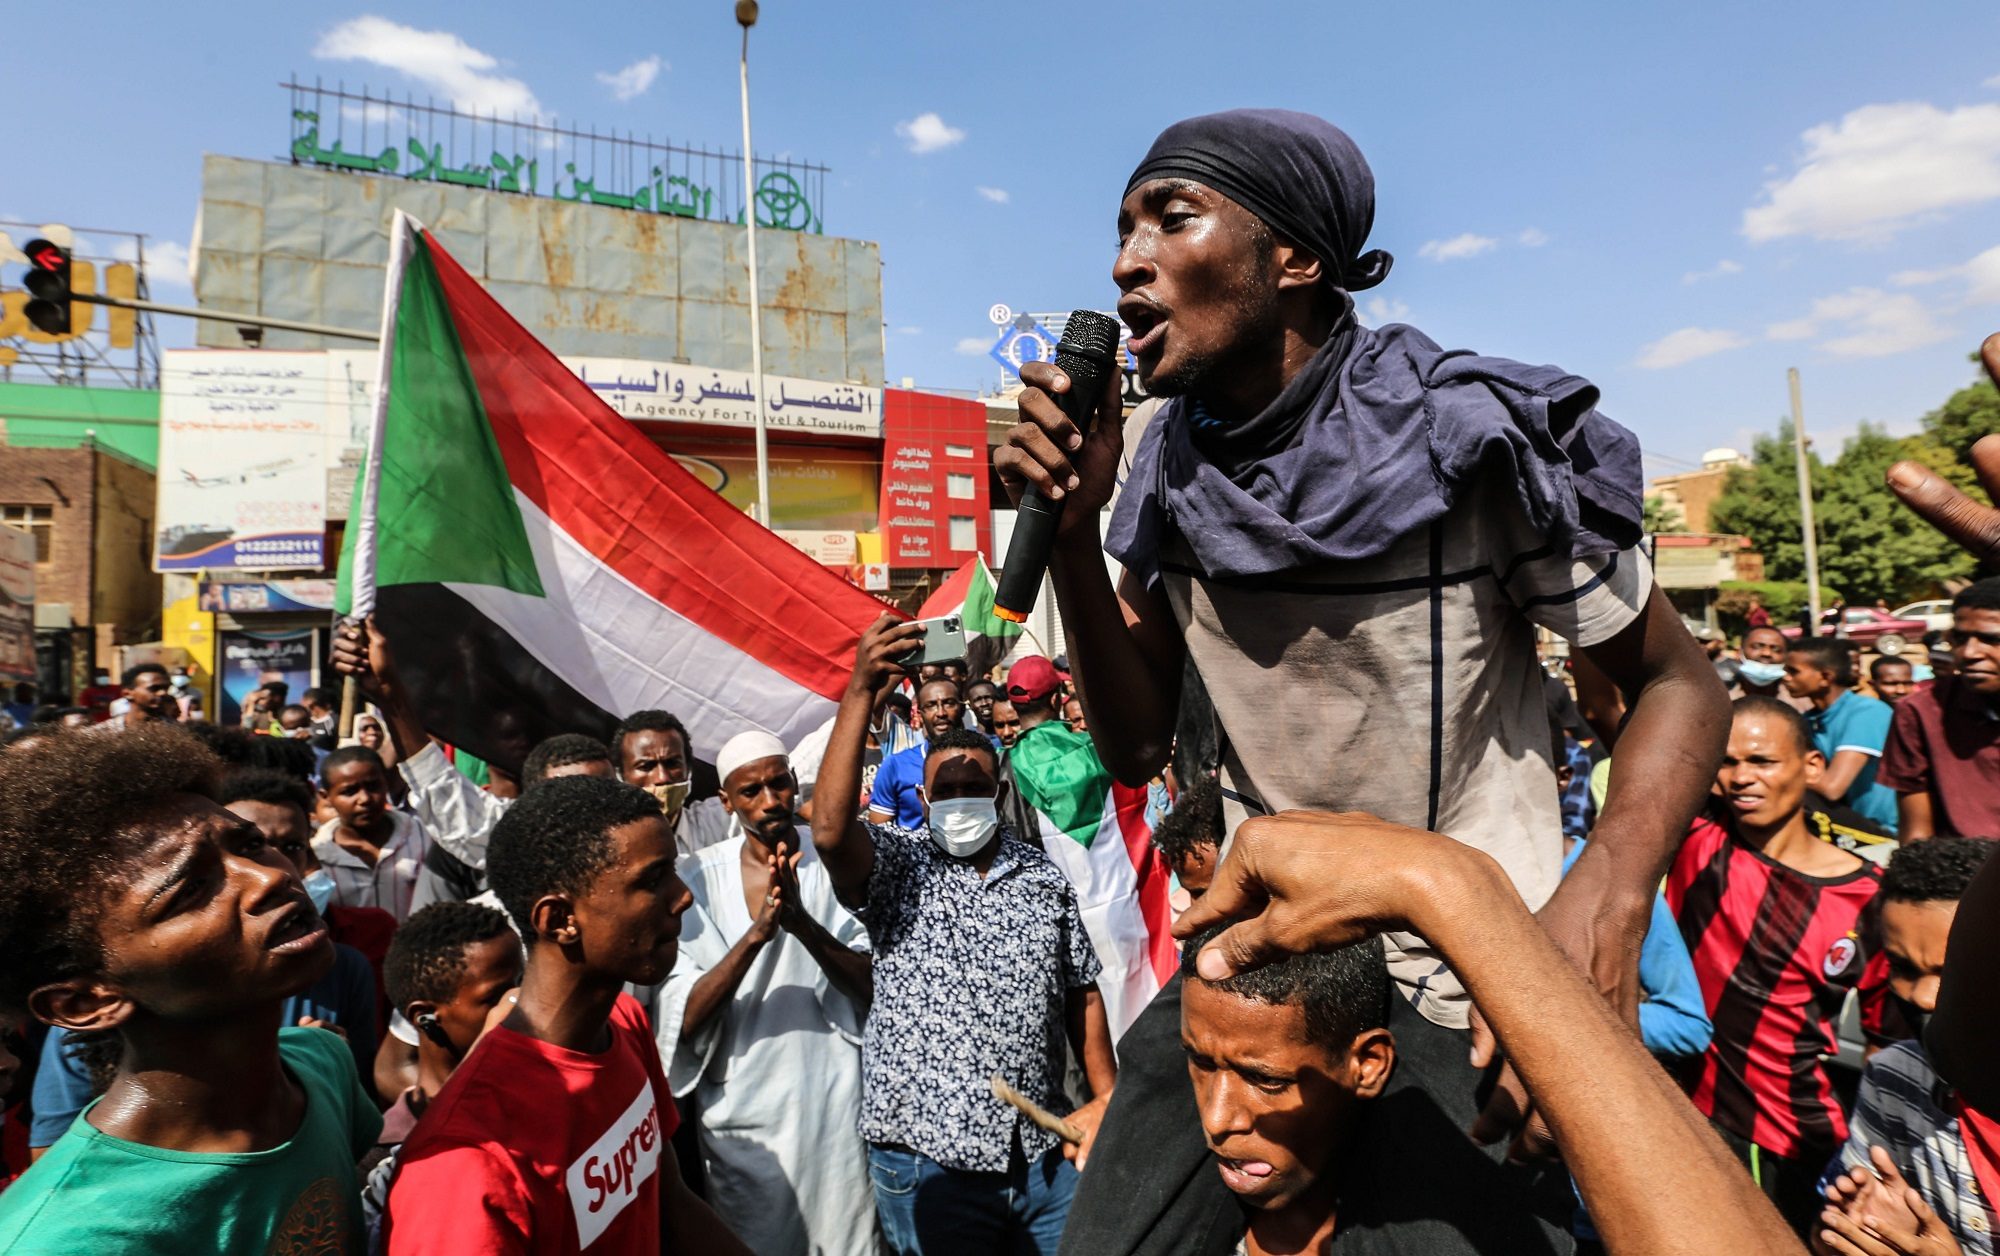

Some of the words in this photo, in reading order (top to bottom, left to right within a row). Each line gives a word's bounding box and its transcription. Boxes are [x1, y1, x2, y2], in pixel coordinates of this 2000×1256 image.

[581, 364, 685, 403] والسيا
[690, 372, 762, 404] لسفر
[769, 381, 871, 413] القنصل
[634, 402, 706, 420] Ageency
[713, 408, 738, 420] For
[745, 411, 790, 426] Trvel
[797, 416, 806, 426] &
[811, 418, 867, 432] Tourism
[584, 1102, 659, 1213] Suprem
